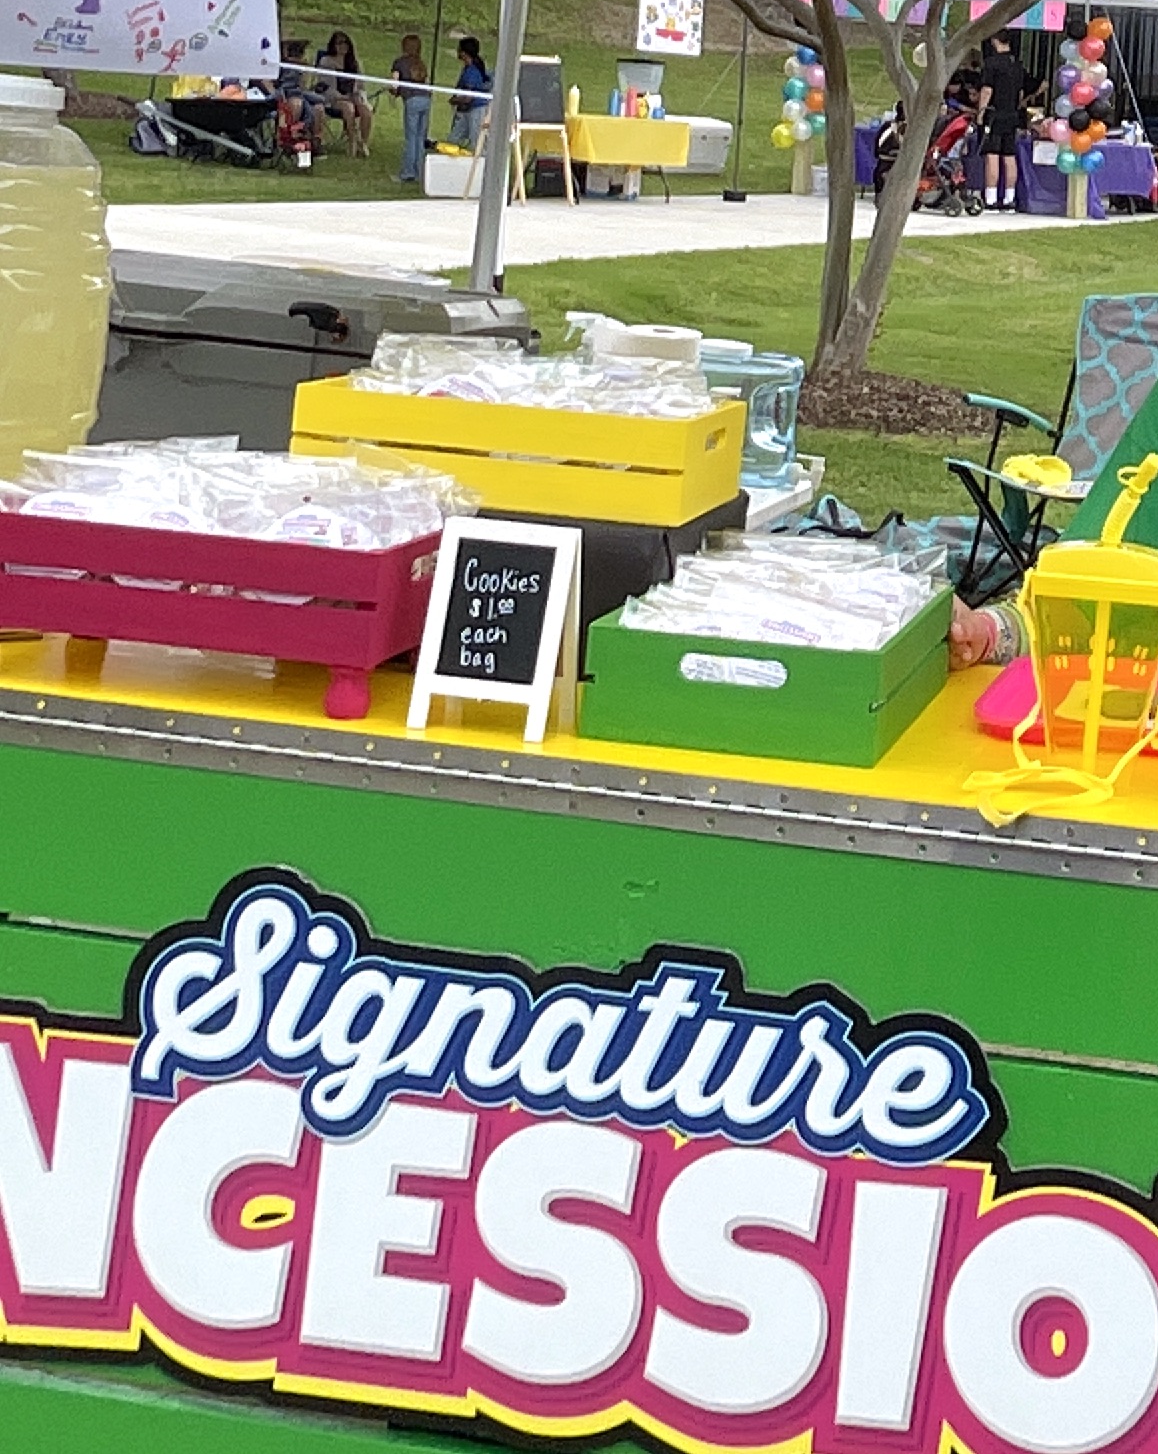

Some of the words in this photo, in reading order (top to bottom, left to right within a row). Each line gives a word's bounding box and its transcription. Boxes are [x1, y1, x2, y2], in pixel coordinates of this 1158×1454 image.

[463, 557, 541, 594] Cookies
[460, 625, 508, 645] each
[460, 645, 496, 673] bag
[139, 893, 970, 1146] Signature
